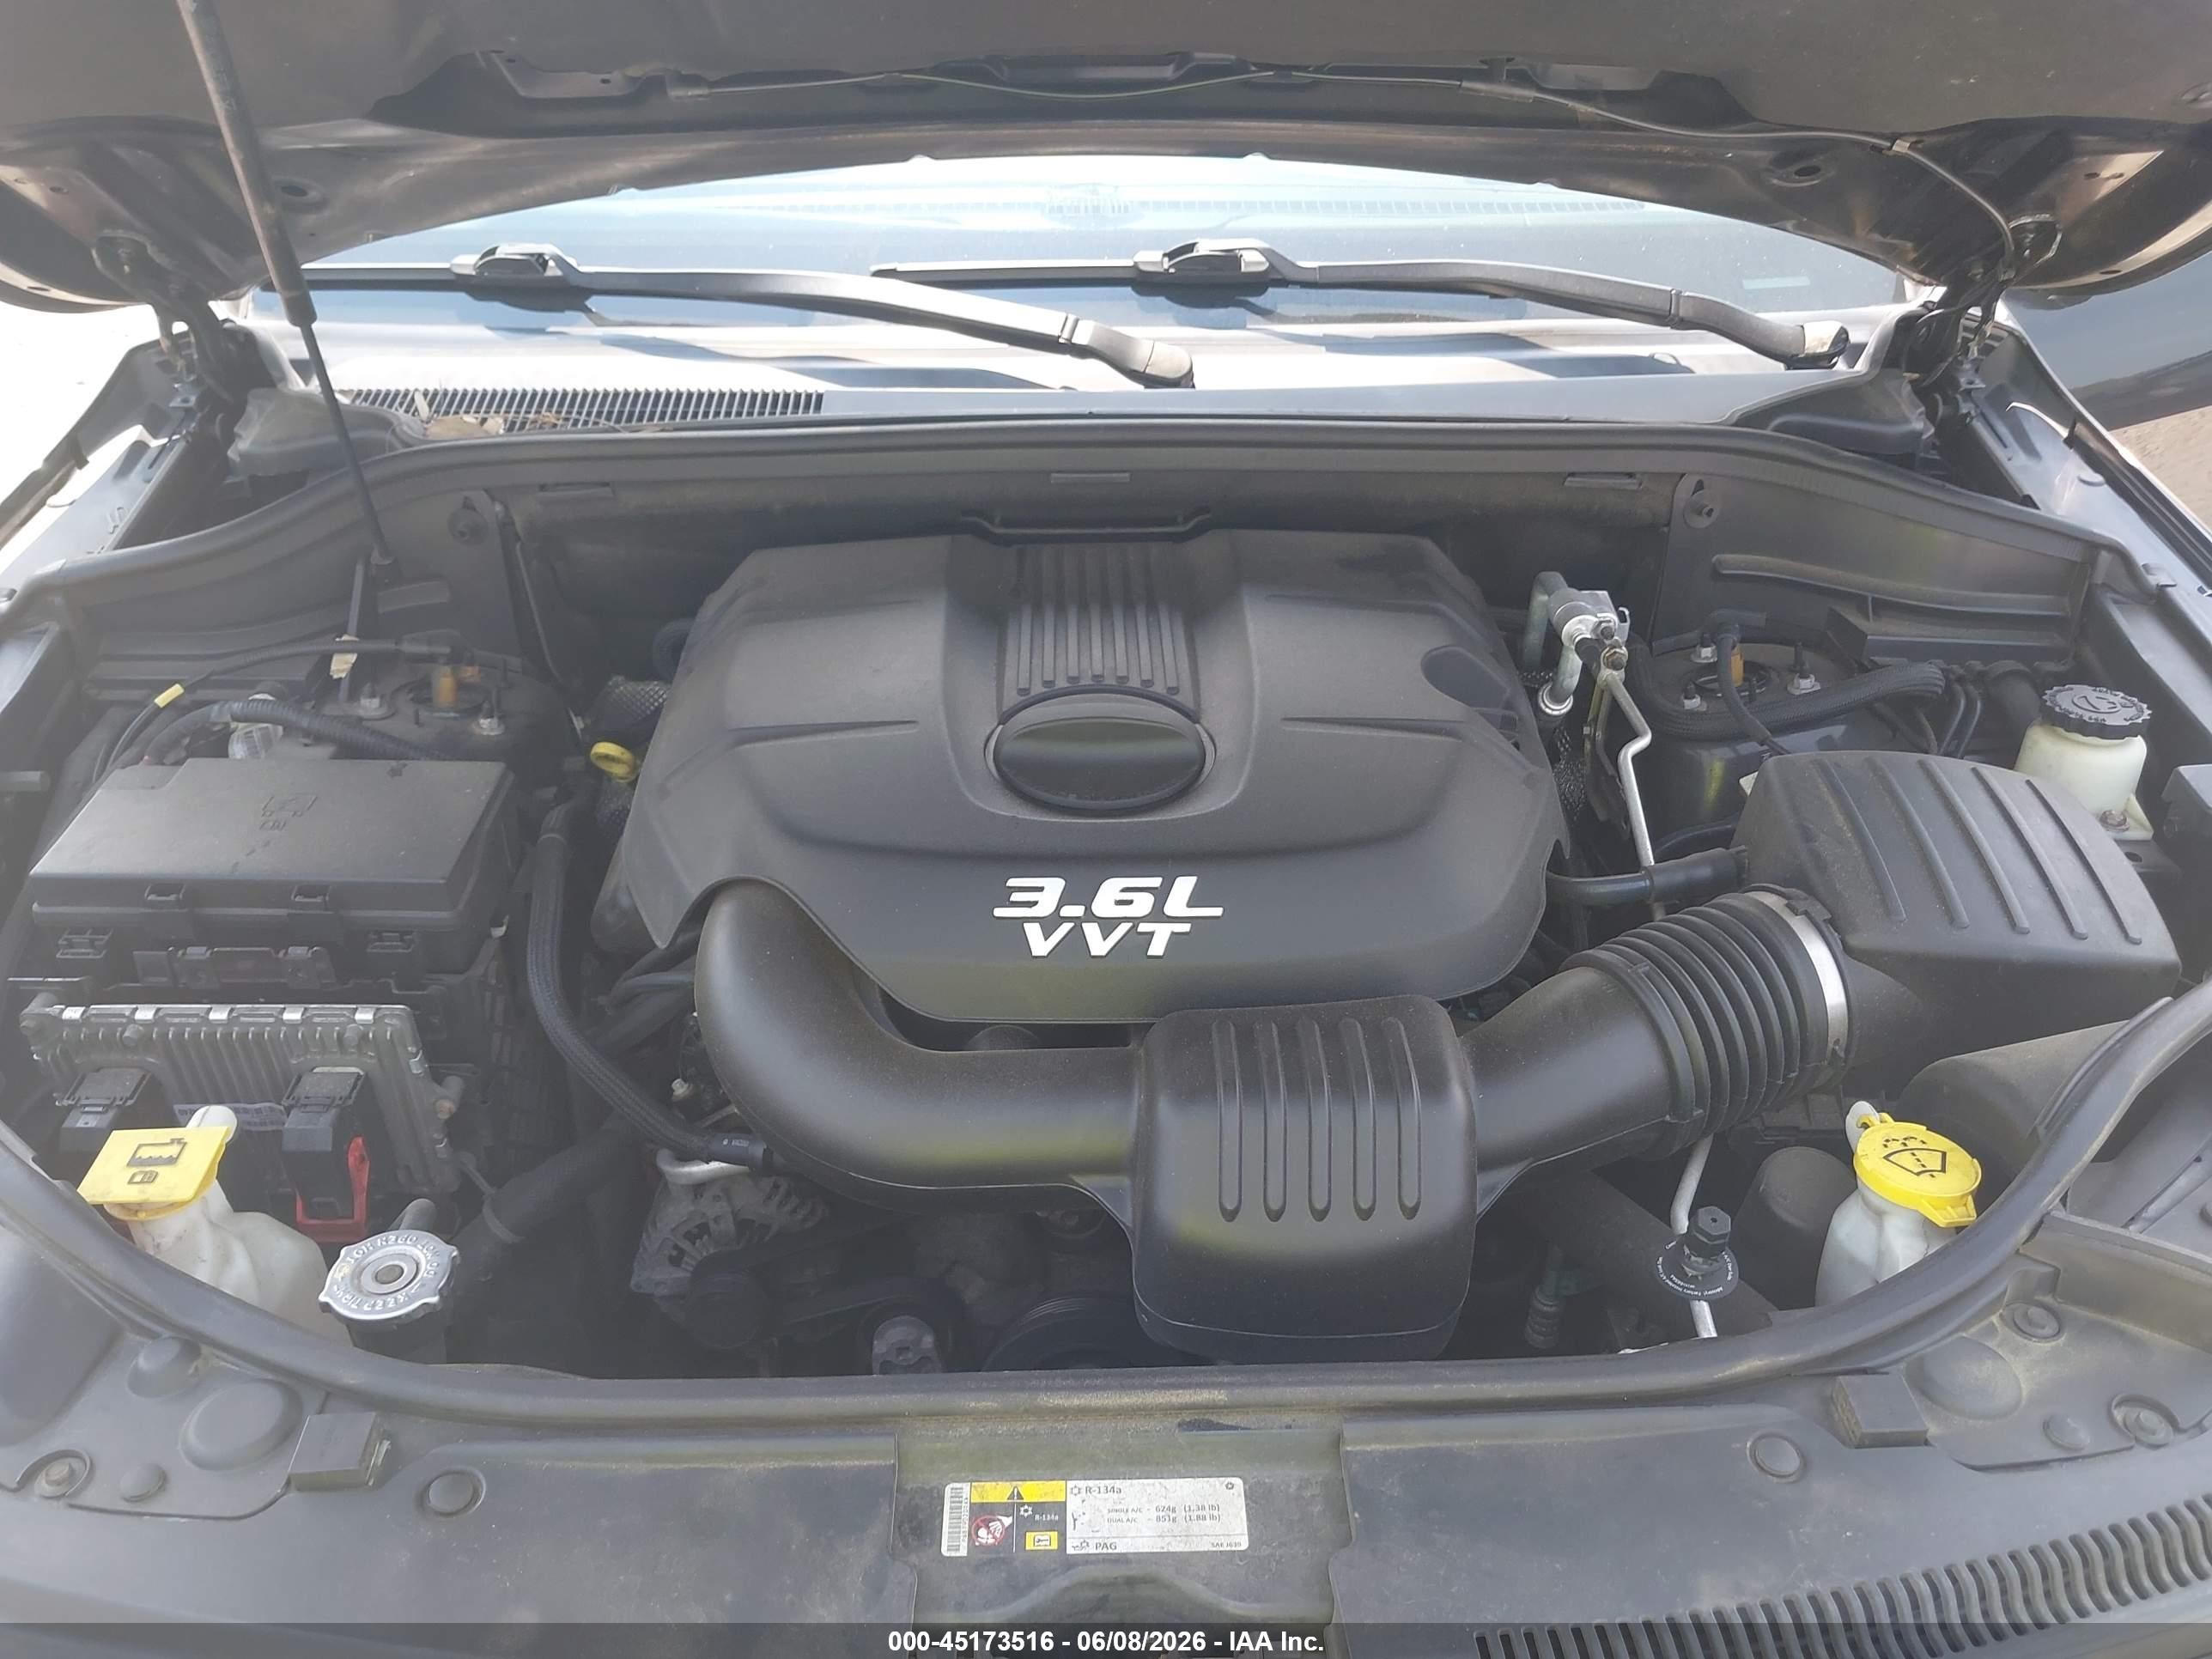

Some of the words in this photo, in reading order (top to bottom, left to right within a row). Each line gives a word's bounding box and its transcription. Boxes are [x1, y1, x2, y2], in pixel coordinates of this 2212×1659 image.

[993, 875, 1224, 919] 3.6L
[1023, 921, 1192, 959] VVT
[1085, 1484, 1122, 1496] R-134a
[1155, 1505, 1176, 1514] 624g
[1183, 1504, 1206, 1513] (1.38
[1156, 1514, 1177, 1523] 851g
[1184, 1514, 1206, 1522] (1.88
[1209, 1514, 1221, 1522] lb)
[1095, 1541, 1117, 1551] PAG
